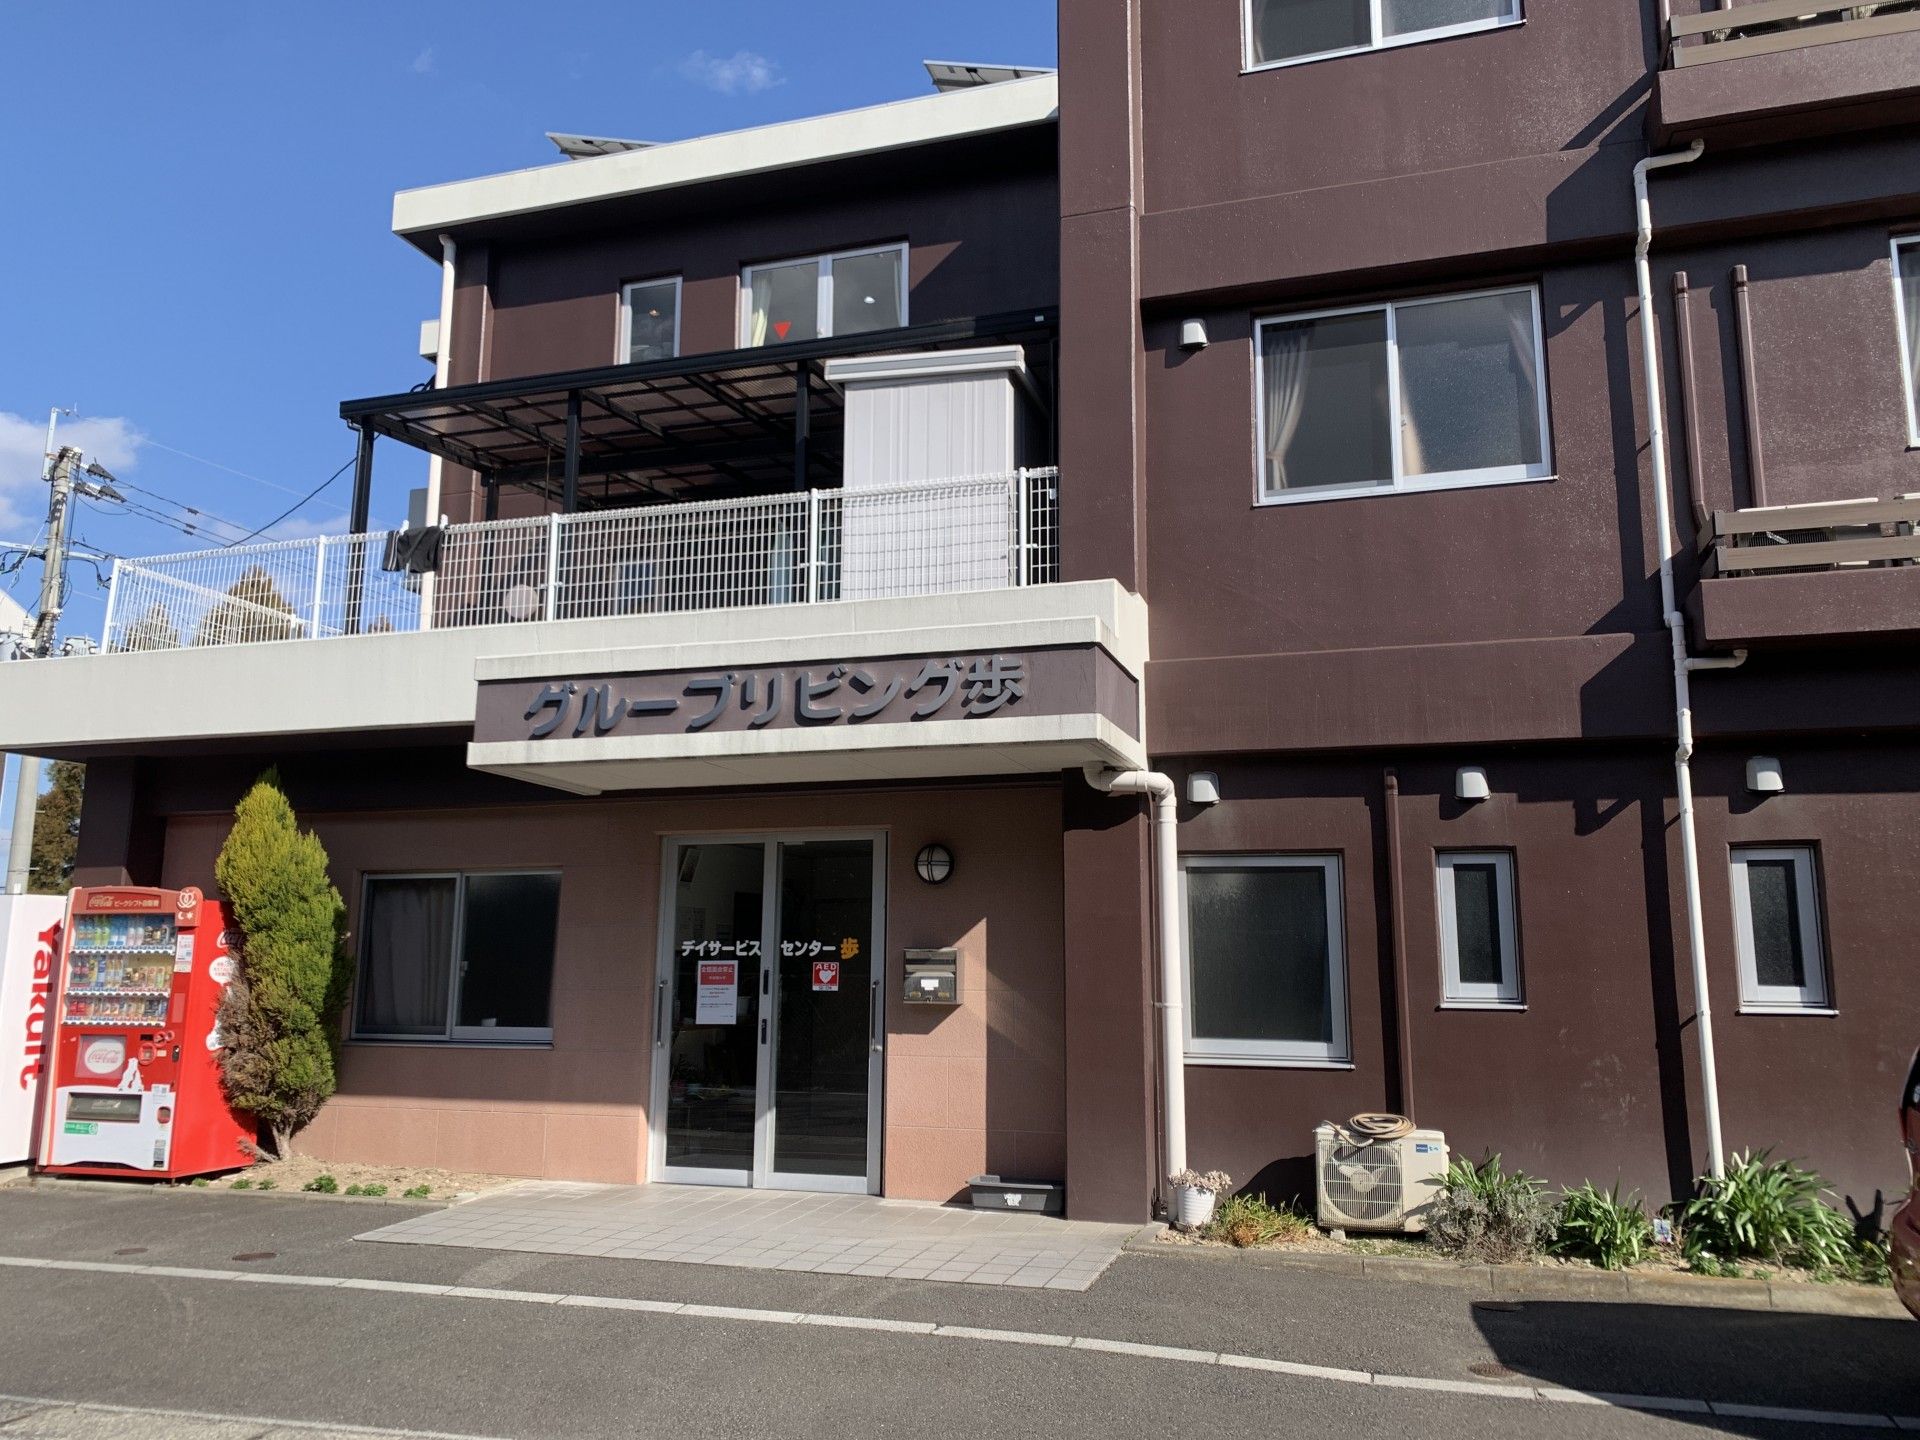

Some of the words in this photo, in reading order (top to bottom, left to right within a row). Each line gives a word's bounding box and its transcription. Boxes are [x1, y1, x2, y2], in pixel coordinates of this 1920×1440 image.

[525, 654, 1024, 737] グループリビング歩
[681, 941, 761, 957] デイサービス
[780, 940, 836, 957] センター
[840, 937, 860, 960] 歩
[20, 918, 62, 1090] Yakult
